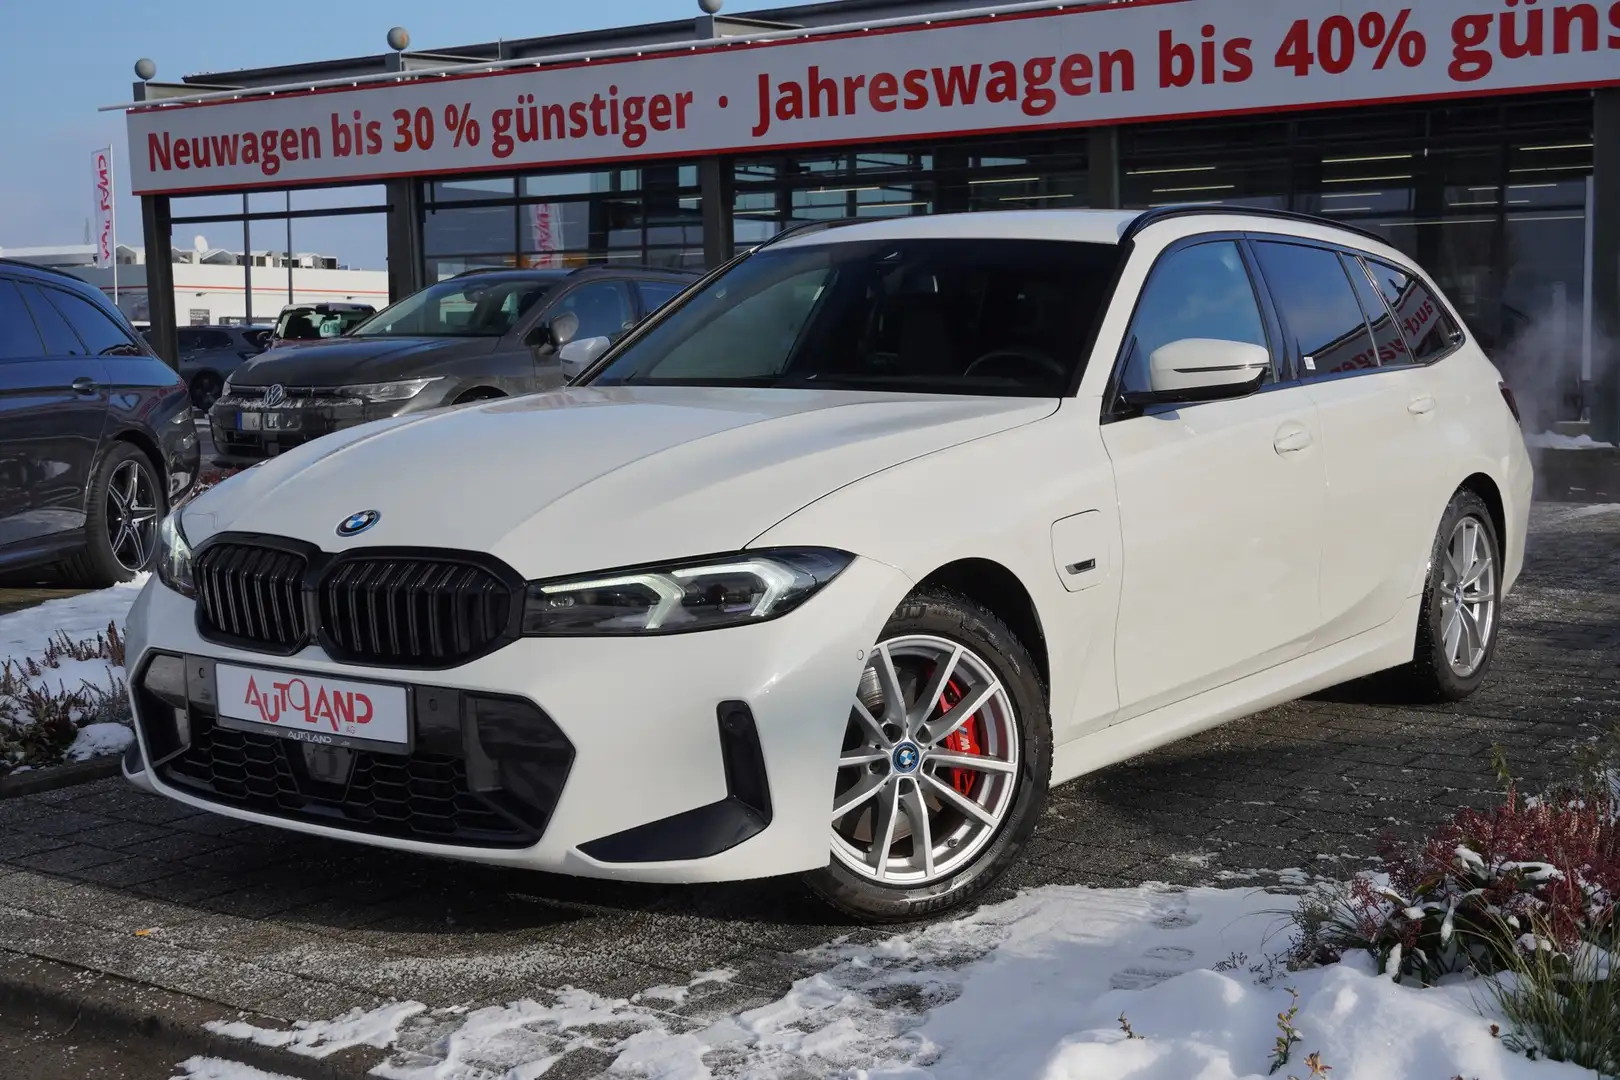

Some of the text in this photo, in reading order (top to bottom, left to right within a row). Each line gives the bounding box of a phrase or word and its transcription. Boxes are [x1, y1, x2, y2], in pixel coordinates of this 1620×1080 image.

[148, 127, 322, 175] Neuwagen
[332, 110, 383, 157] bis
[393, 107, 436, 153] 30
[444, 103, 482, 149] %
[490, 84, 694, 159] günstiger
[751, 49, 1135, 137] Jahreswagen
[1158, 24, 1253, 89] bis
[1274, 9, 1427, 77] 40%
[244, 673, 375, 732] AUTOLAND
[287, 730, 332, 744] AUTOLAND
